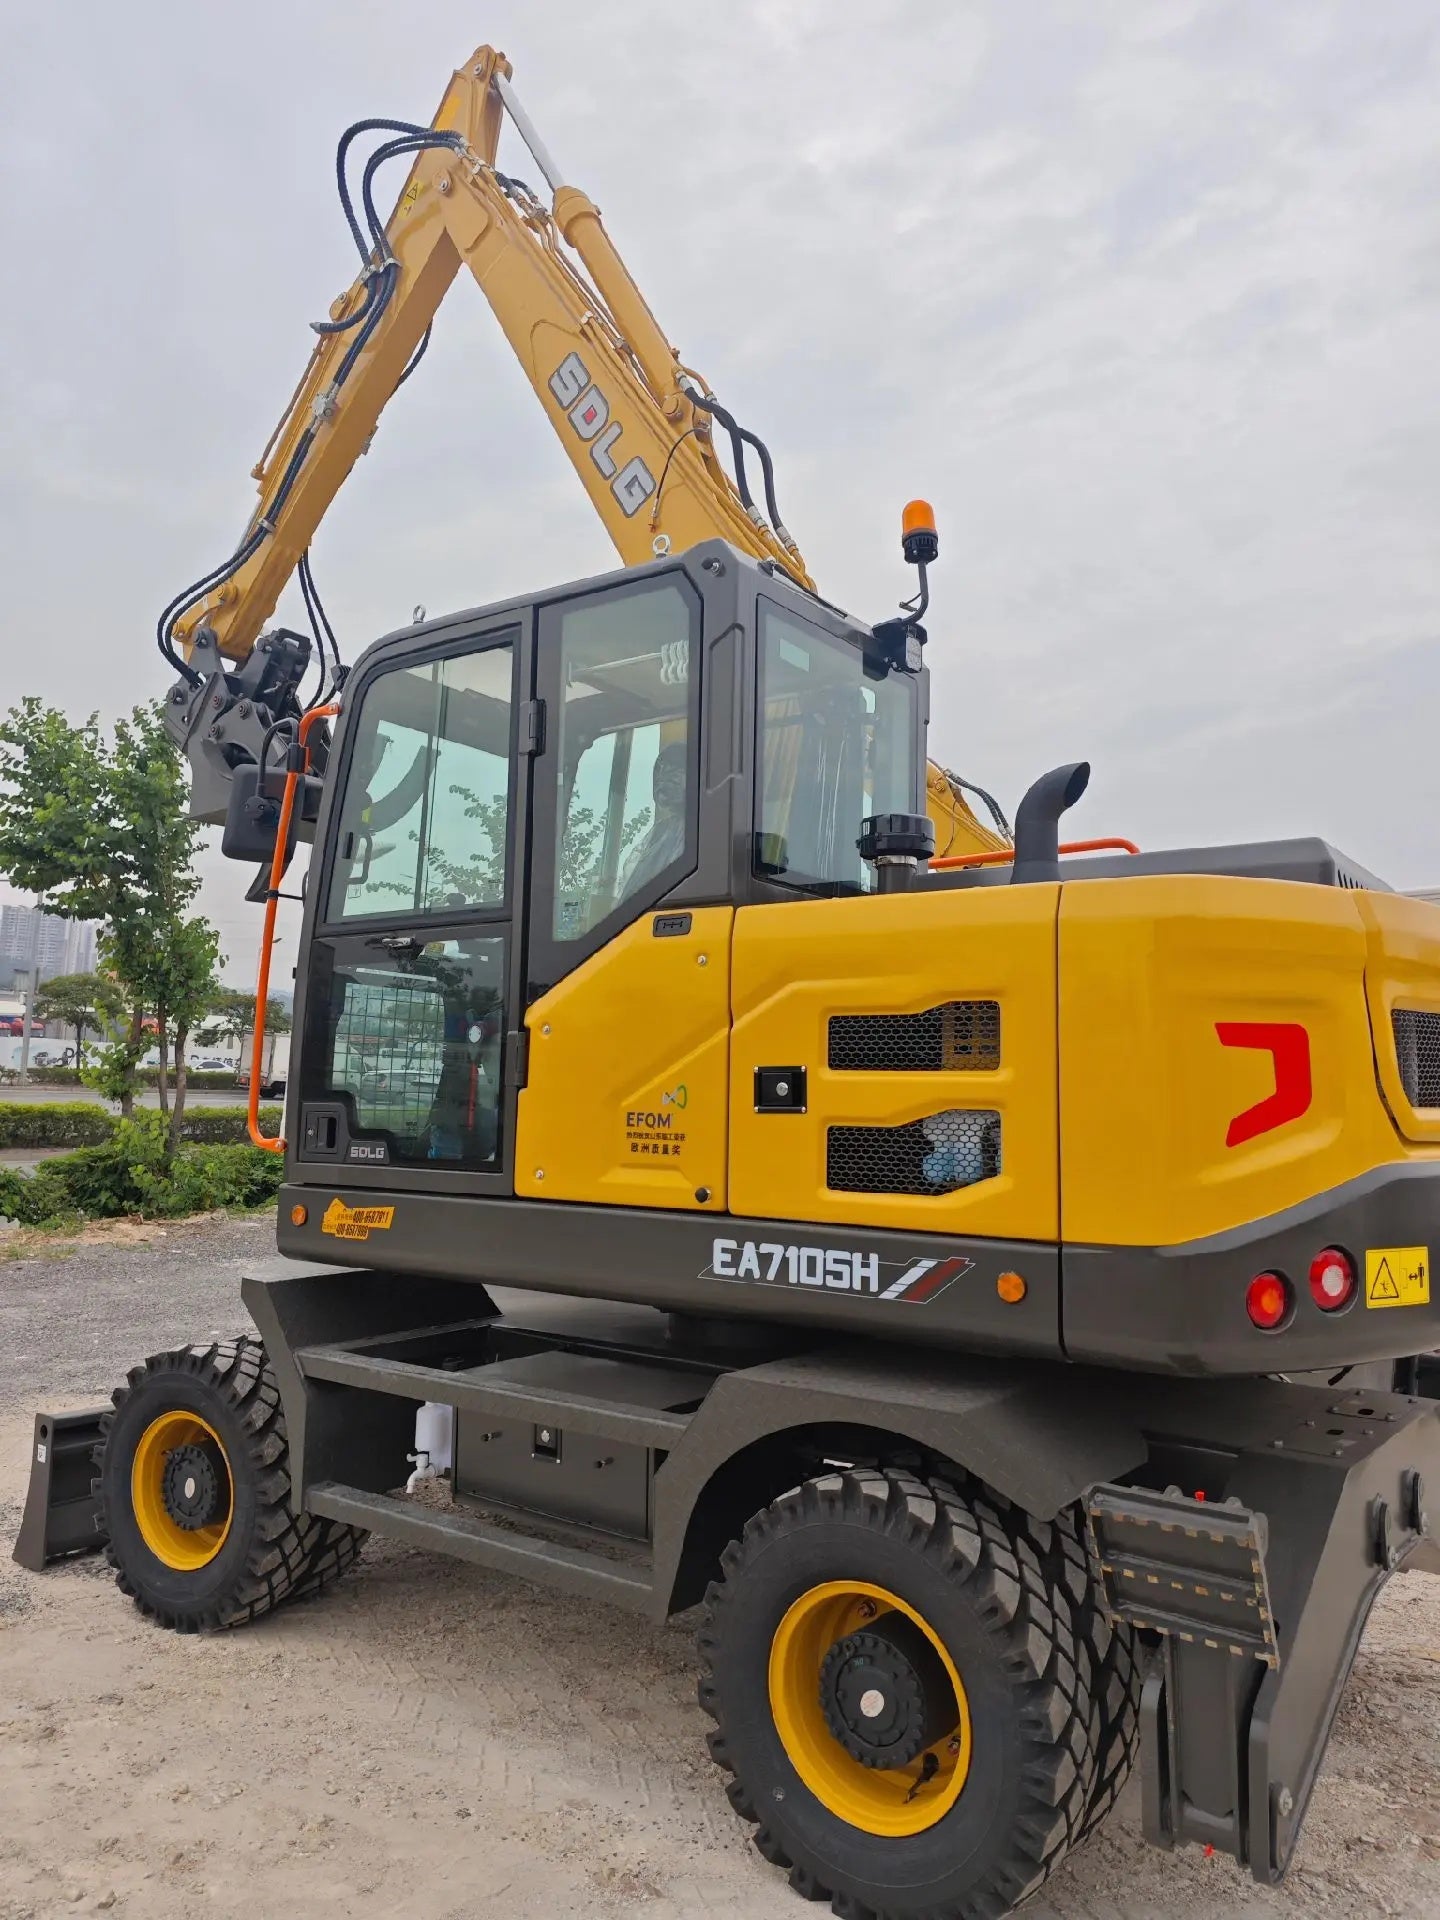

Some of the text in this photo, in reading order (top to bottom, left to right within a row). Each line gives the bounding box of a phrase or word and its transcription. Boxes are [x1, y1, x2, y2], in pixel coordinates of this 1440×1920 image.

[548, 351, 657, 518] SDLG
[626, 1112, 671, 1129] EFQM
[350, 1146, 385, 1159] SDLG
[631, 1142, 680, 1155] 欧洲质量奖
